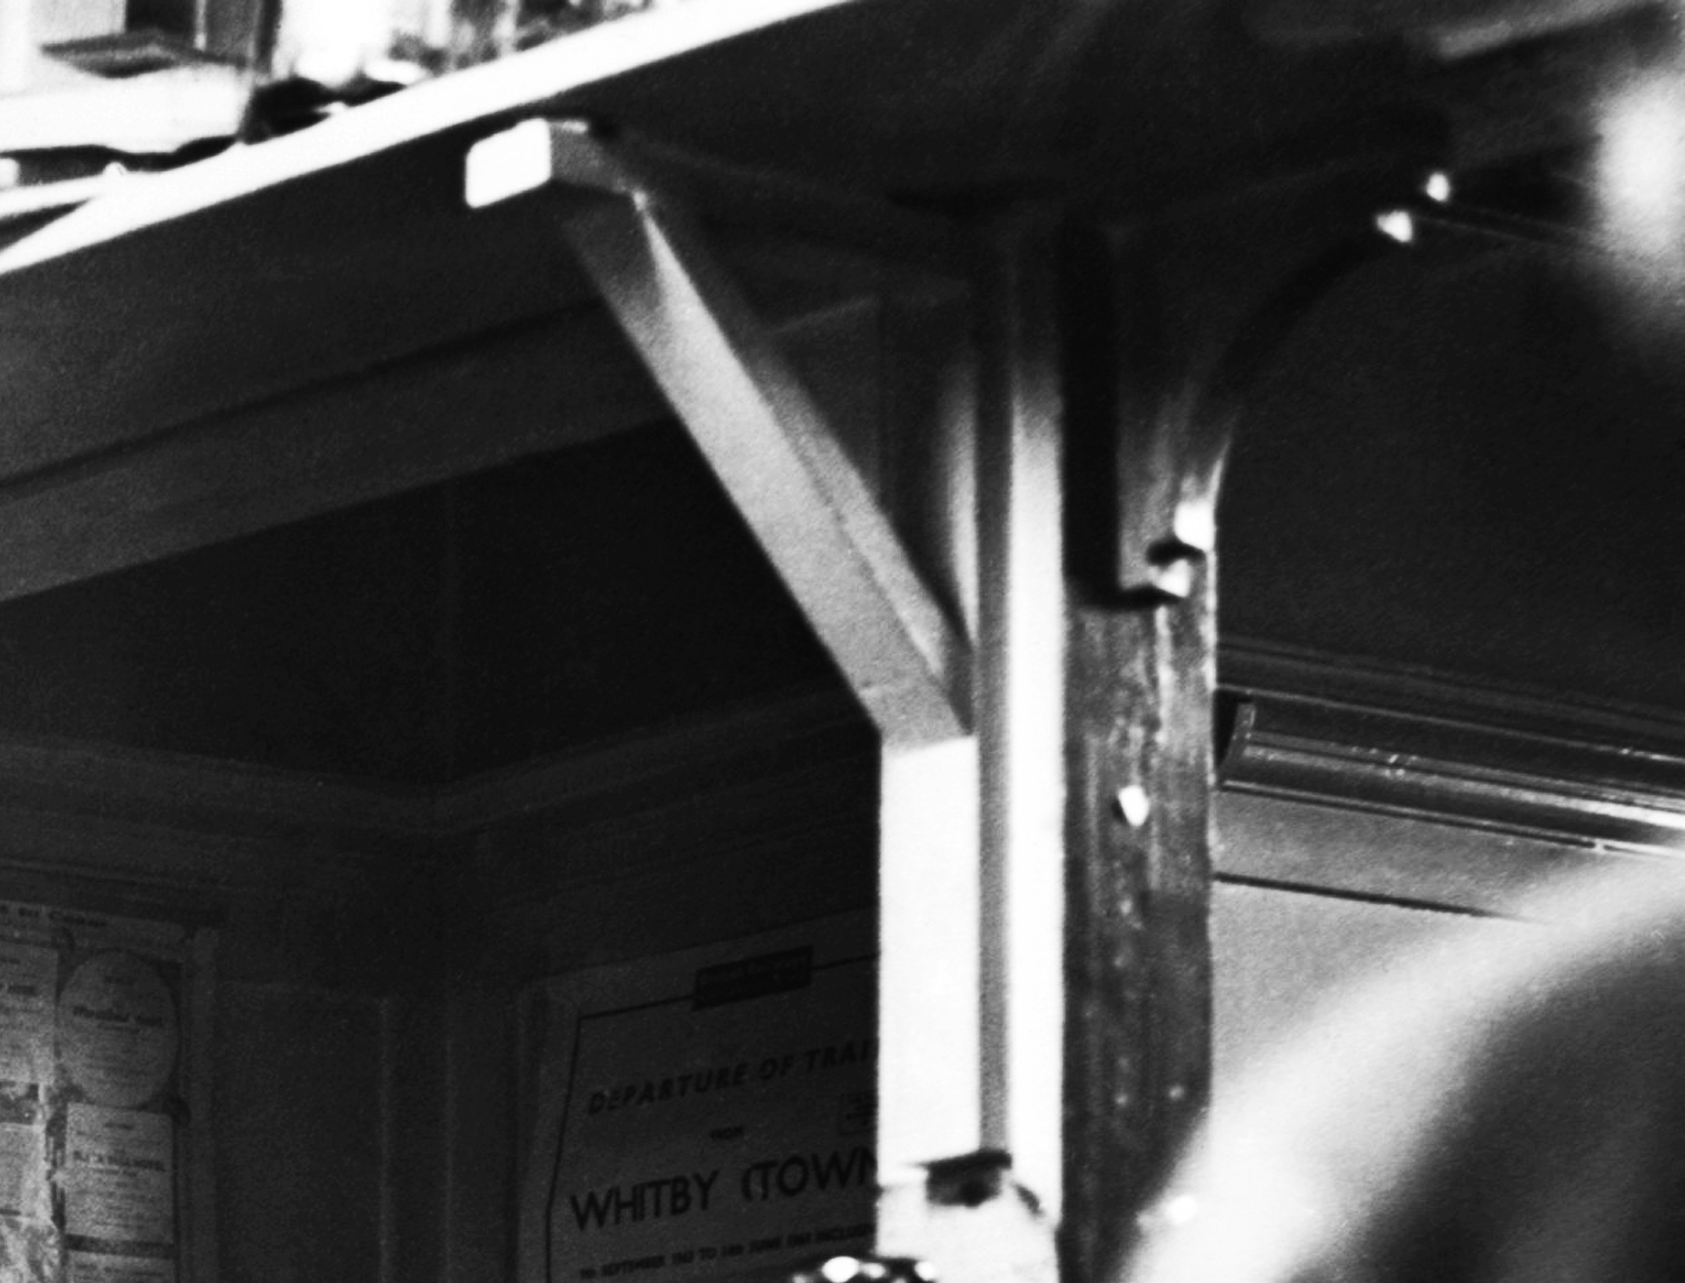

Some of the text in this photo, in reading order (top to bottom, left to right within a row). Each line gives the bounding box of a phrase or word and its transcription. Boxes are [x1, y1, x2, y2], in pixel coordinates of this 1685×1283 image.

[587, 1038, 875, 1117] DEPARTURE OF TRAI
[570, 1170, 720, 1231] WHITBY
